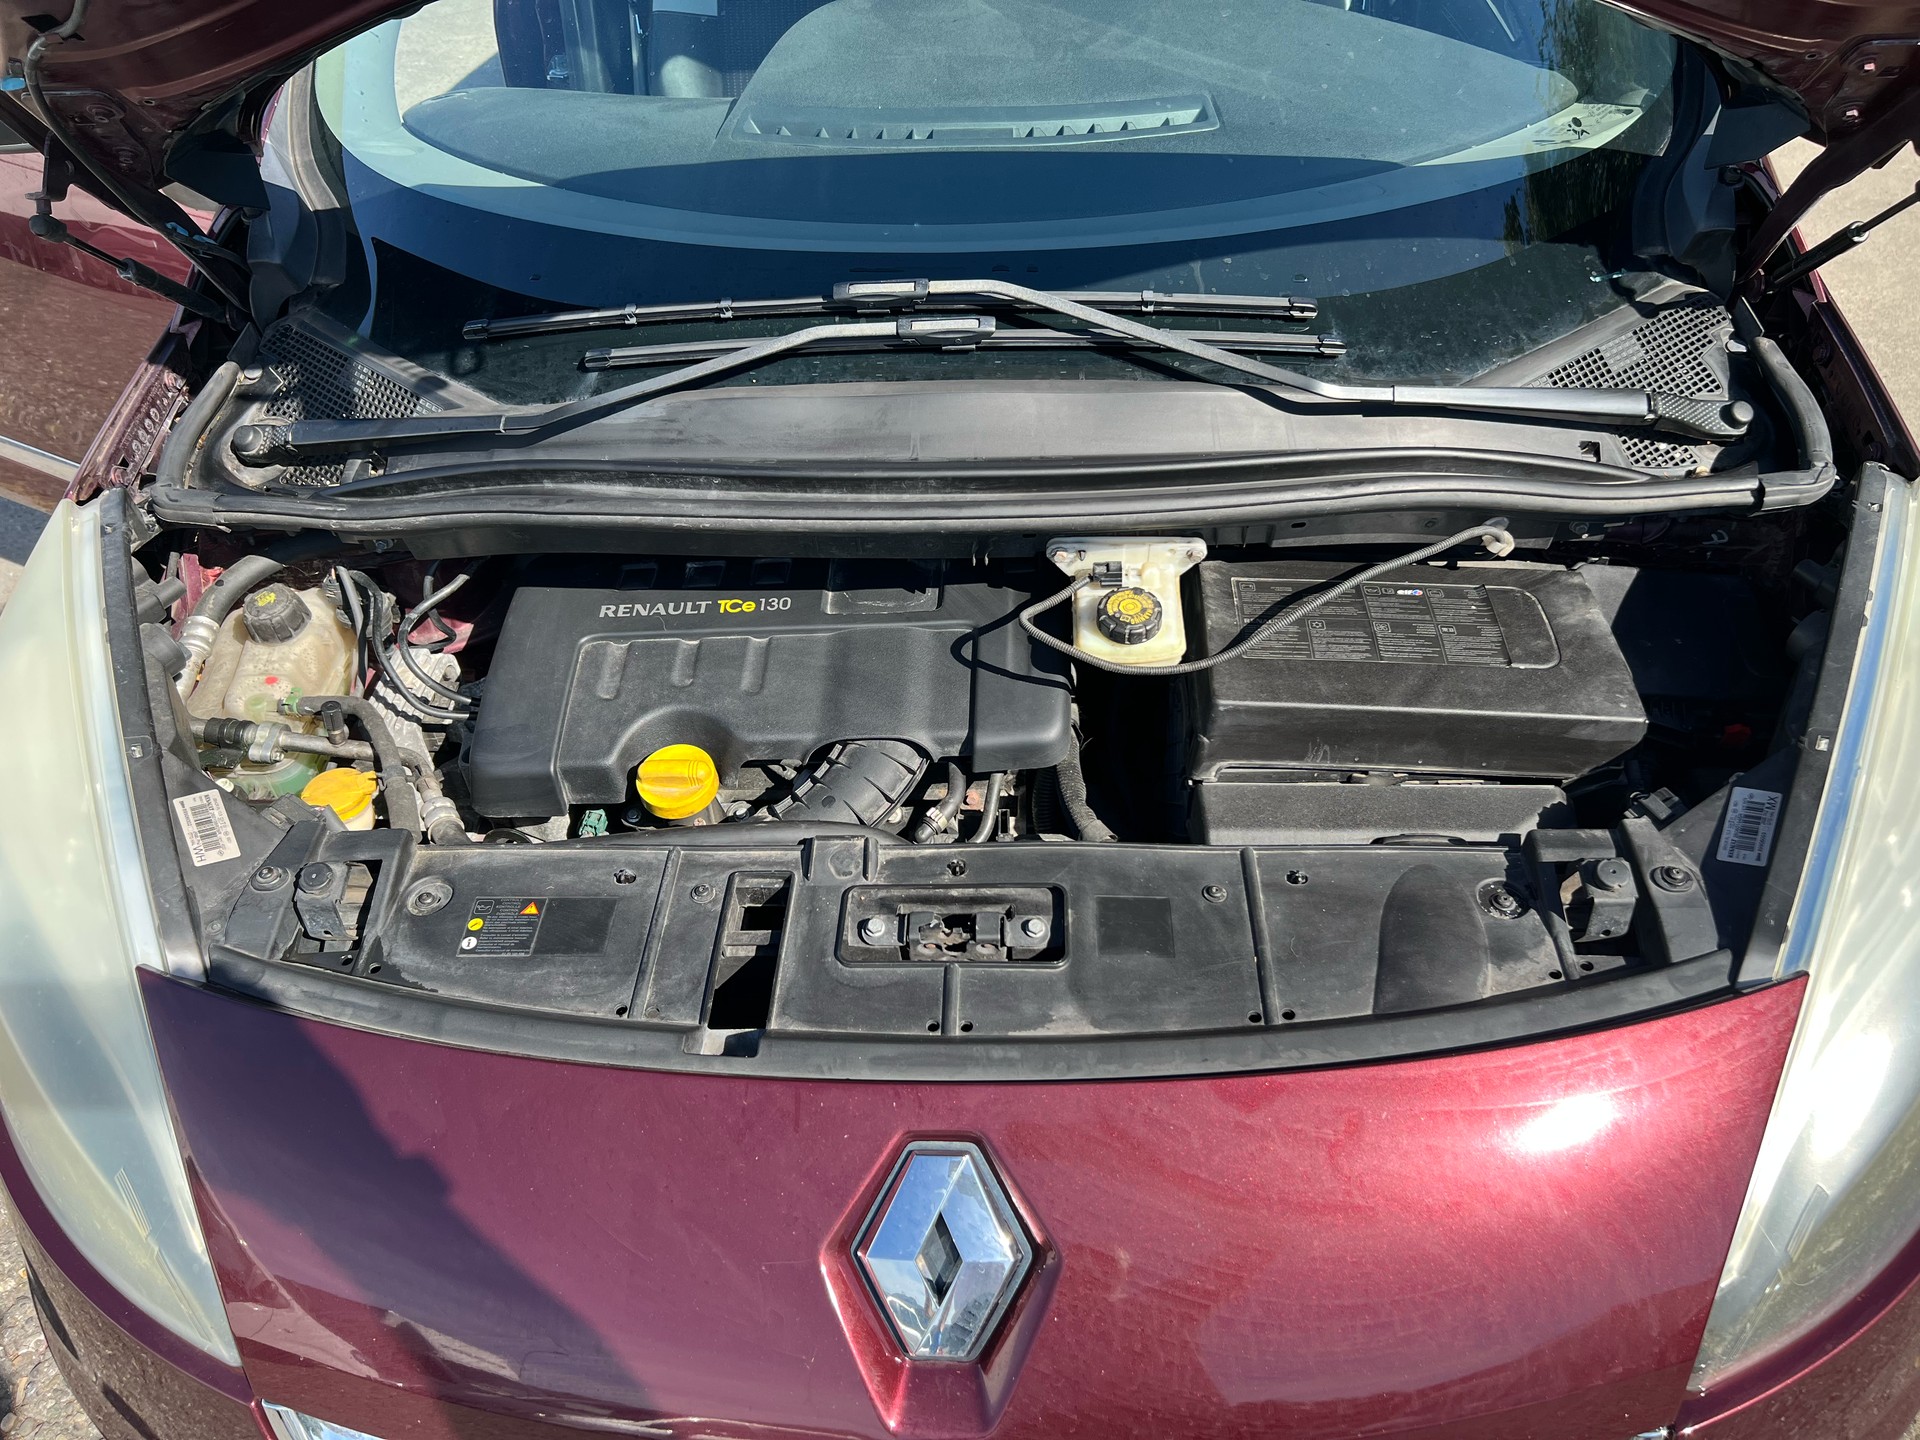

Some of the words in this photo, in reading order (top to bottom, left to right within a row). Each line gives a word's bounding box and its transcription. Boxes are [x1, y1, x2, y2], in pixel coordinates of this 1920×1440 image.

[599, 600, 712, 618] RENAULT
[717, 599, 756, 613] TCe
[759, 597, 791, 611] 130
[1765, 795, 1779, 811] MX
[192, 845, 206, 863] WH
